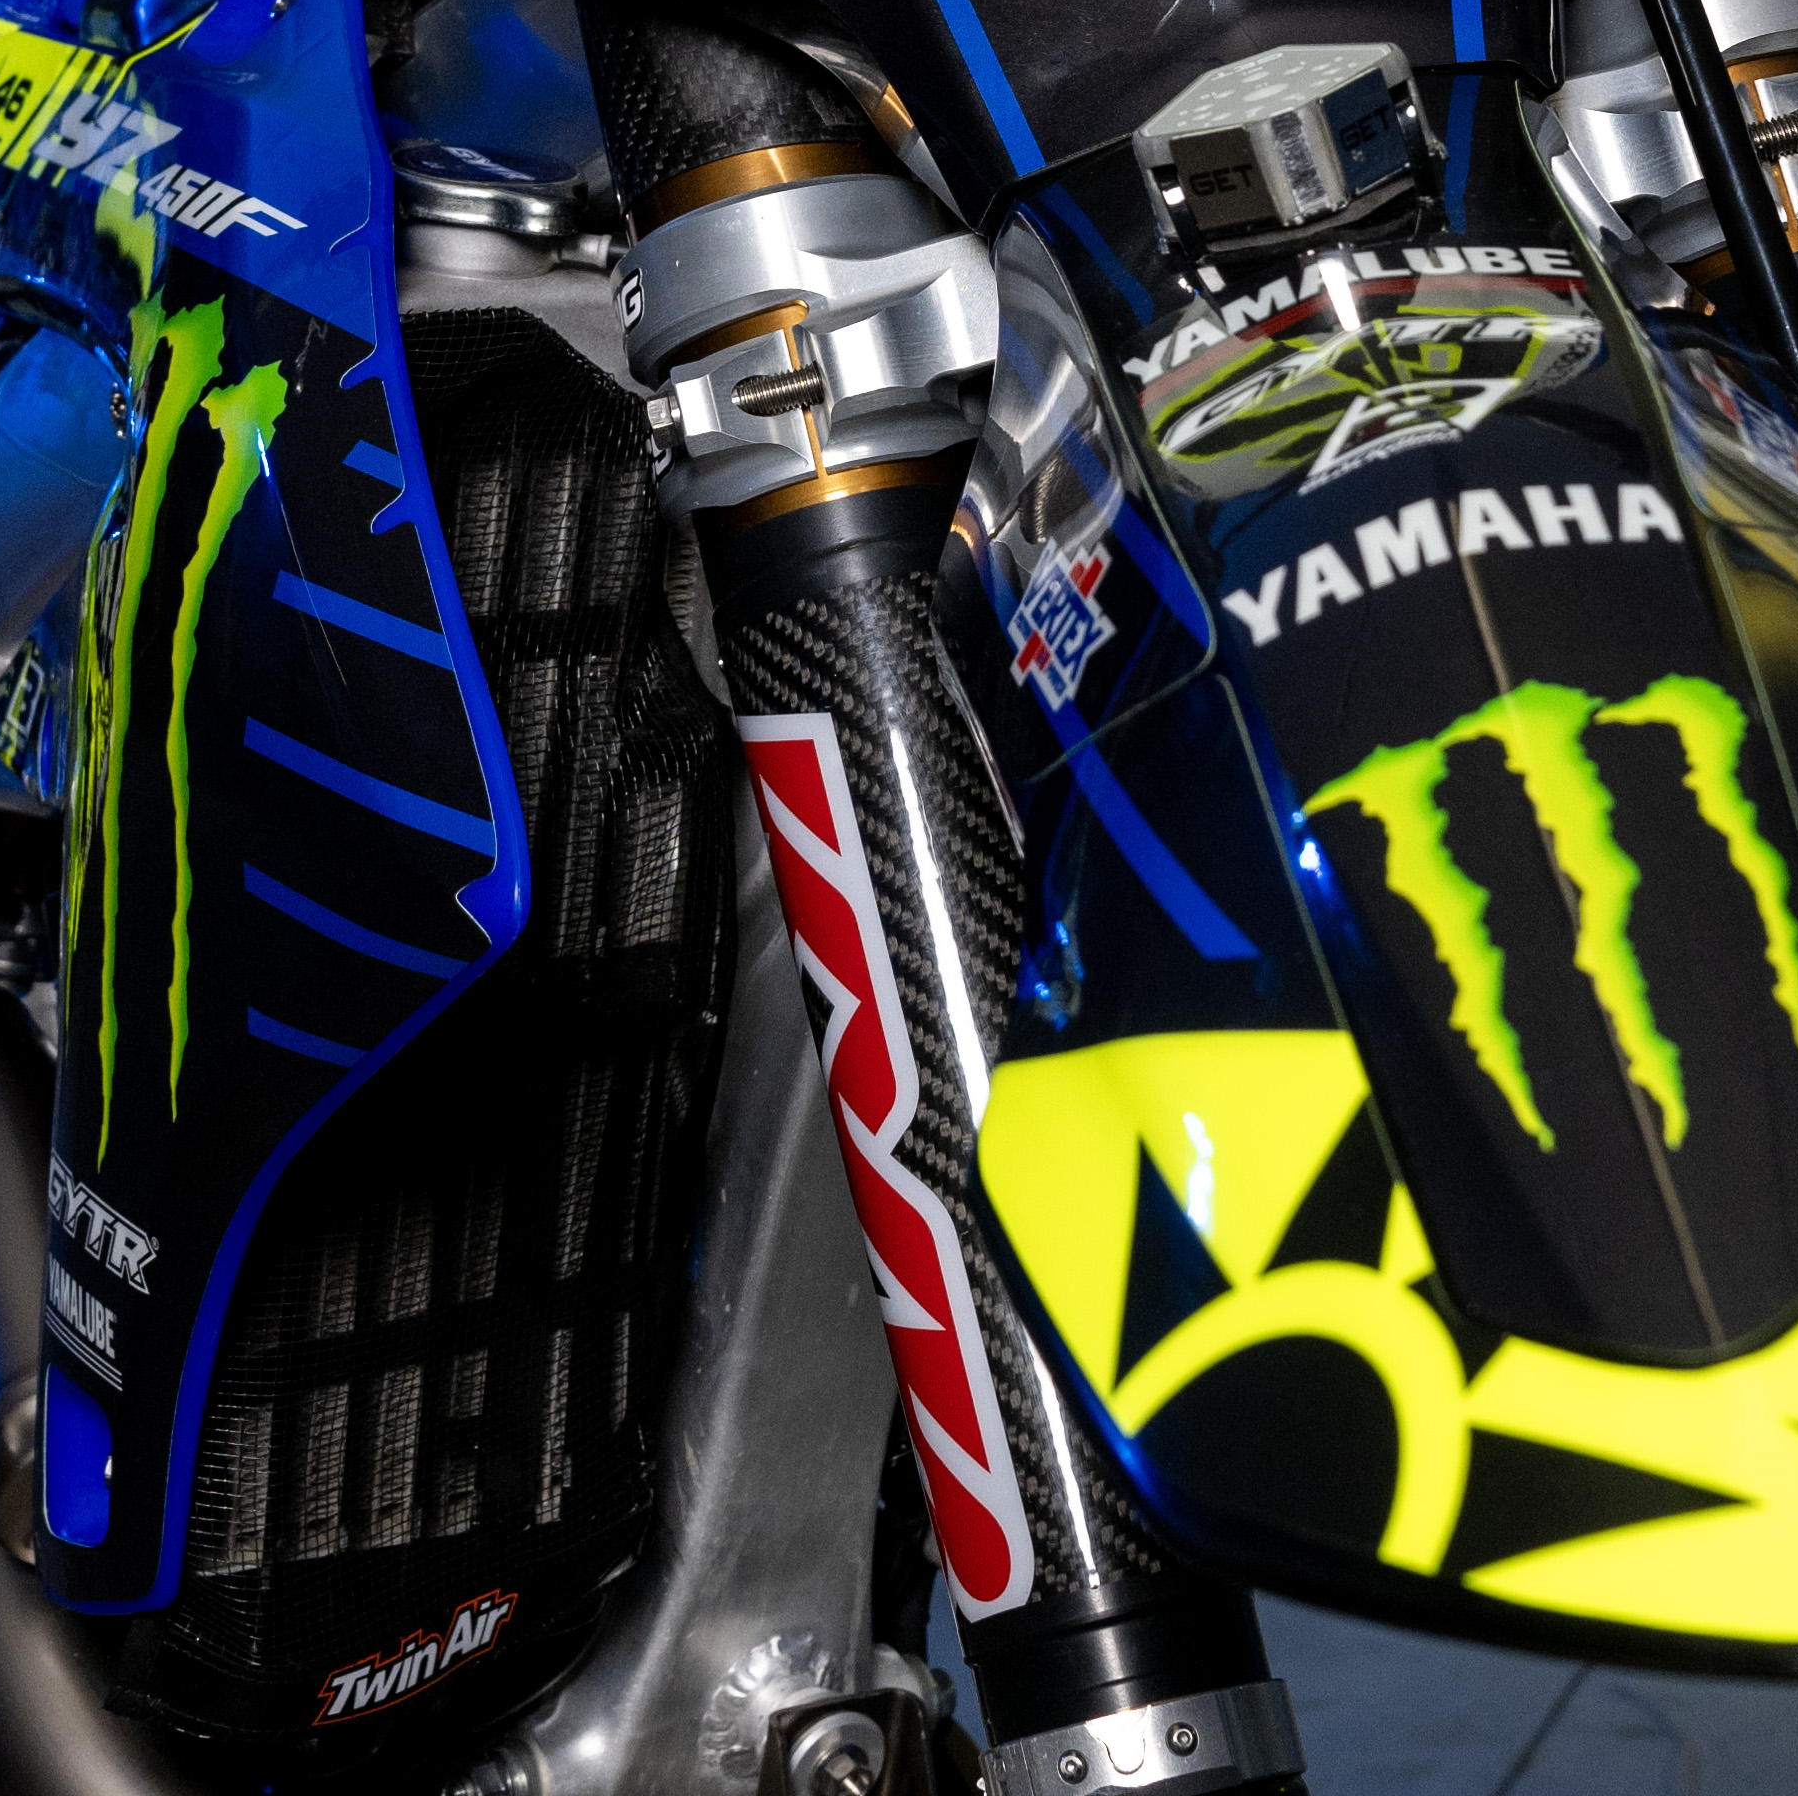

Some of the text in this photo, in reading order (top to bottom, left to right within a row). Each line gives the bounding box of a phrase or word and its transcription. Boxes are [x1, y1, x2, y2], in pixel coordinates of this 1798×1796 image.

[1188, 163, 1253, 197] GET
[1338, 105, 1391, 152] GET
[1122, 245, 1584, 385] YAMALUBE
[1221, 481, 1684, 647] YAMAHA
[48, 1147, 158, 1295] GYTR
[48, 1252, 116, 1359] YAMALUBE
[327, 1600, 510, 1717] Twin Air
